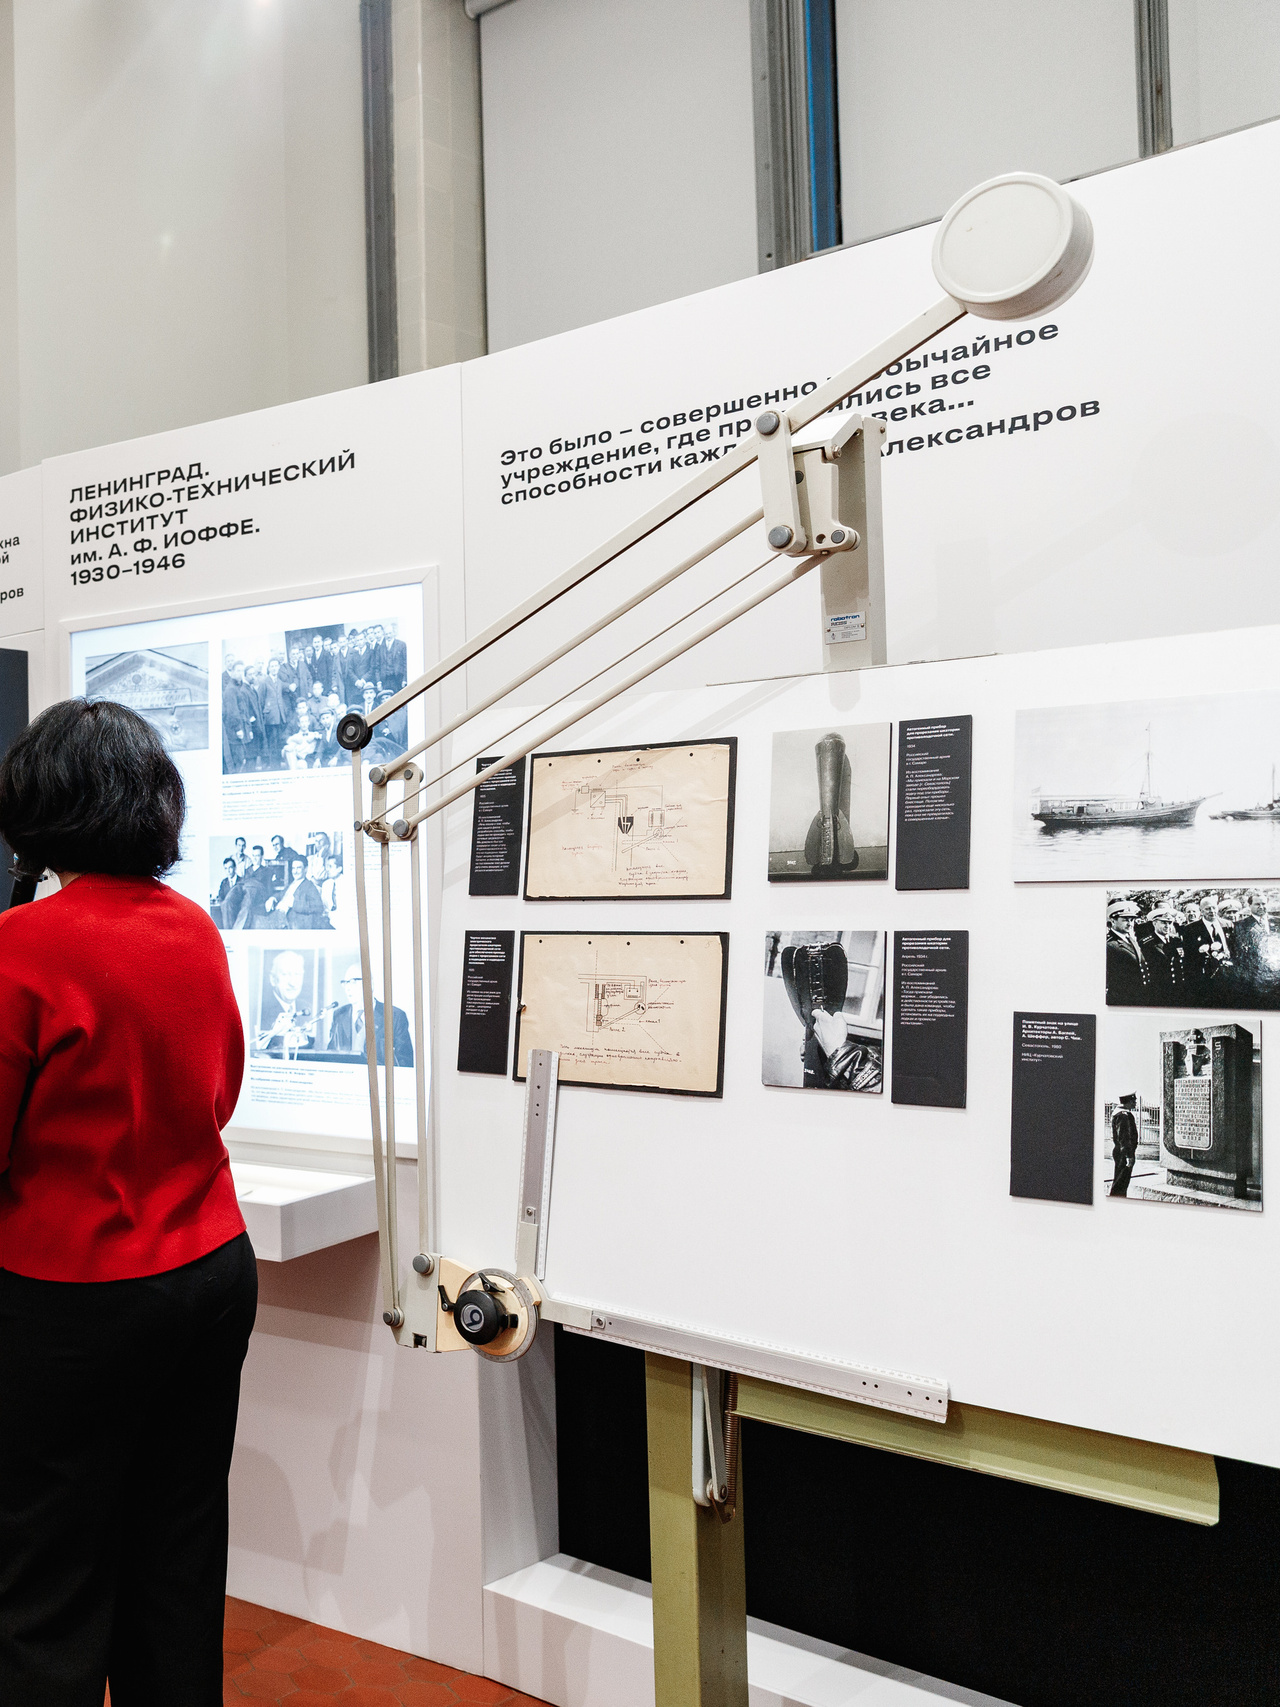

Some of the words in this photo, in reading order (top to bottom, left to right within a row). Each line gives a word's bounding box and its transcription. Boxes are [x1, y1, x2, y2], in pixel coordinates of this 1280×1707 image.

[501, 446, 543, 466] Это
[549, 430, 612, 456] было
[640, 380, 818, 434] совершенно
[501, 440, 660, 489] учреждение,
[667, 428, 711, 450] где
[930, 364, 991, 391] все
[880, 399, 1101, 457] лександров
[70, 462, 210, 503] ЛЕНИНГРАД.
[70, 448, 356, 523] ФИЗИКО-ТЕХНИЧЕСКИЙ
[501, 459, 662, 505] способности
[70, 509, 188, 544] ИНСТИТУТ
[71, 550, 102, 565] им.
[109, 543, 128, 558] А.
[133, 538, 157, 553] Ф.
[164, 518, 260, 549] ИОФФЕ.
